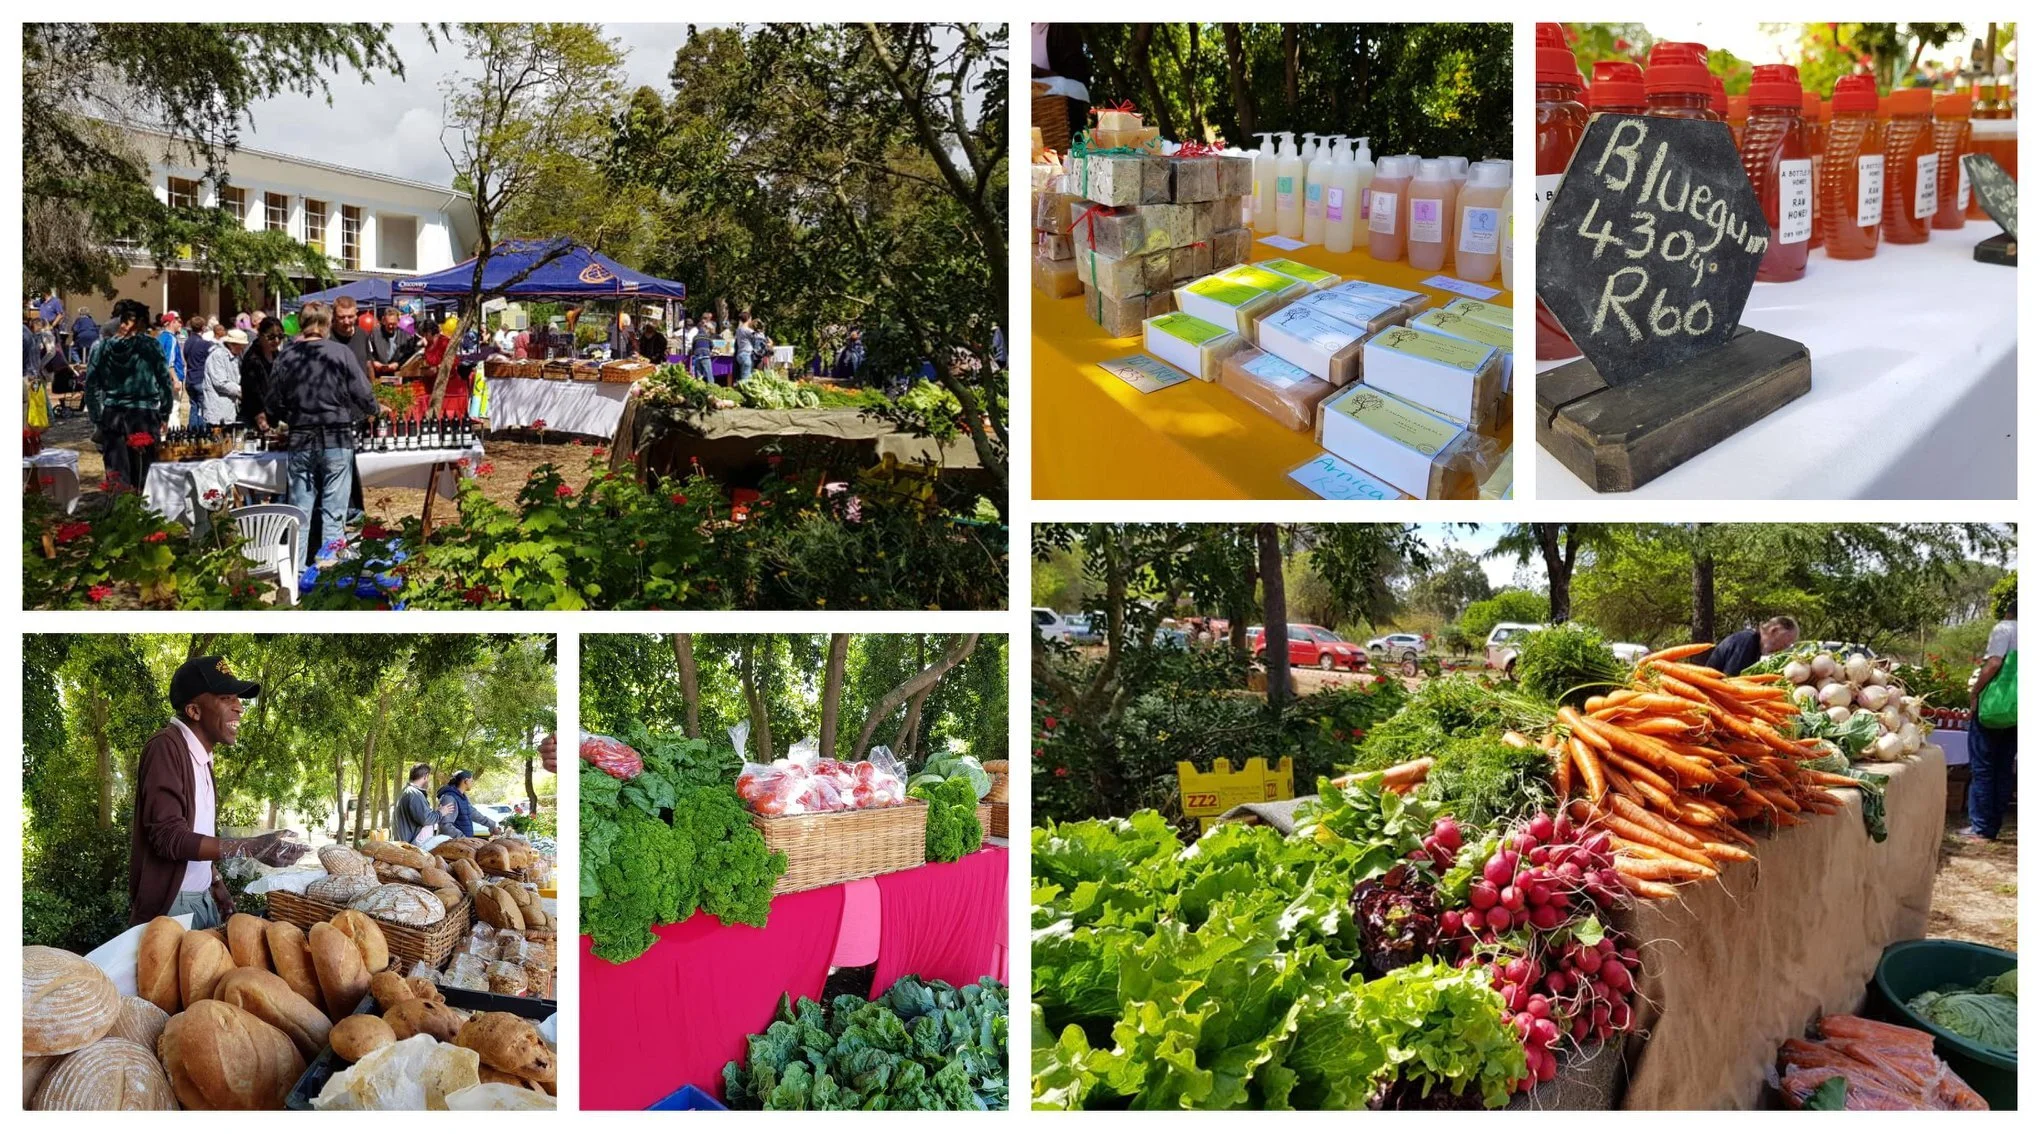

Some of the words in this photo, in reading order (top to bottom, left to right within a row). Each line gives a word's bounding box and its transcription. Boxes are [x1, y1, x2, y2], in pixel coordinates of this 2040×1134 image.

[1593, 119, 1768, 254] Bluegum
[1787, 209, 1808, 220] HONEY
[1792, 198, 1806, 207] RAW
[1590, 266, 1714, 345] R60
[1313, 457, 1384, 500] Arnica
[1187, 794, 1218, 808] ZZ2
